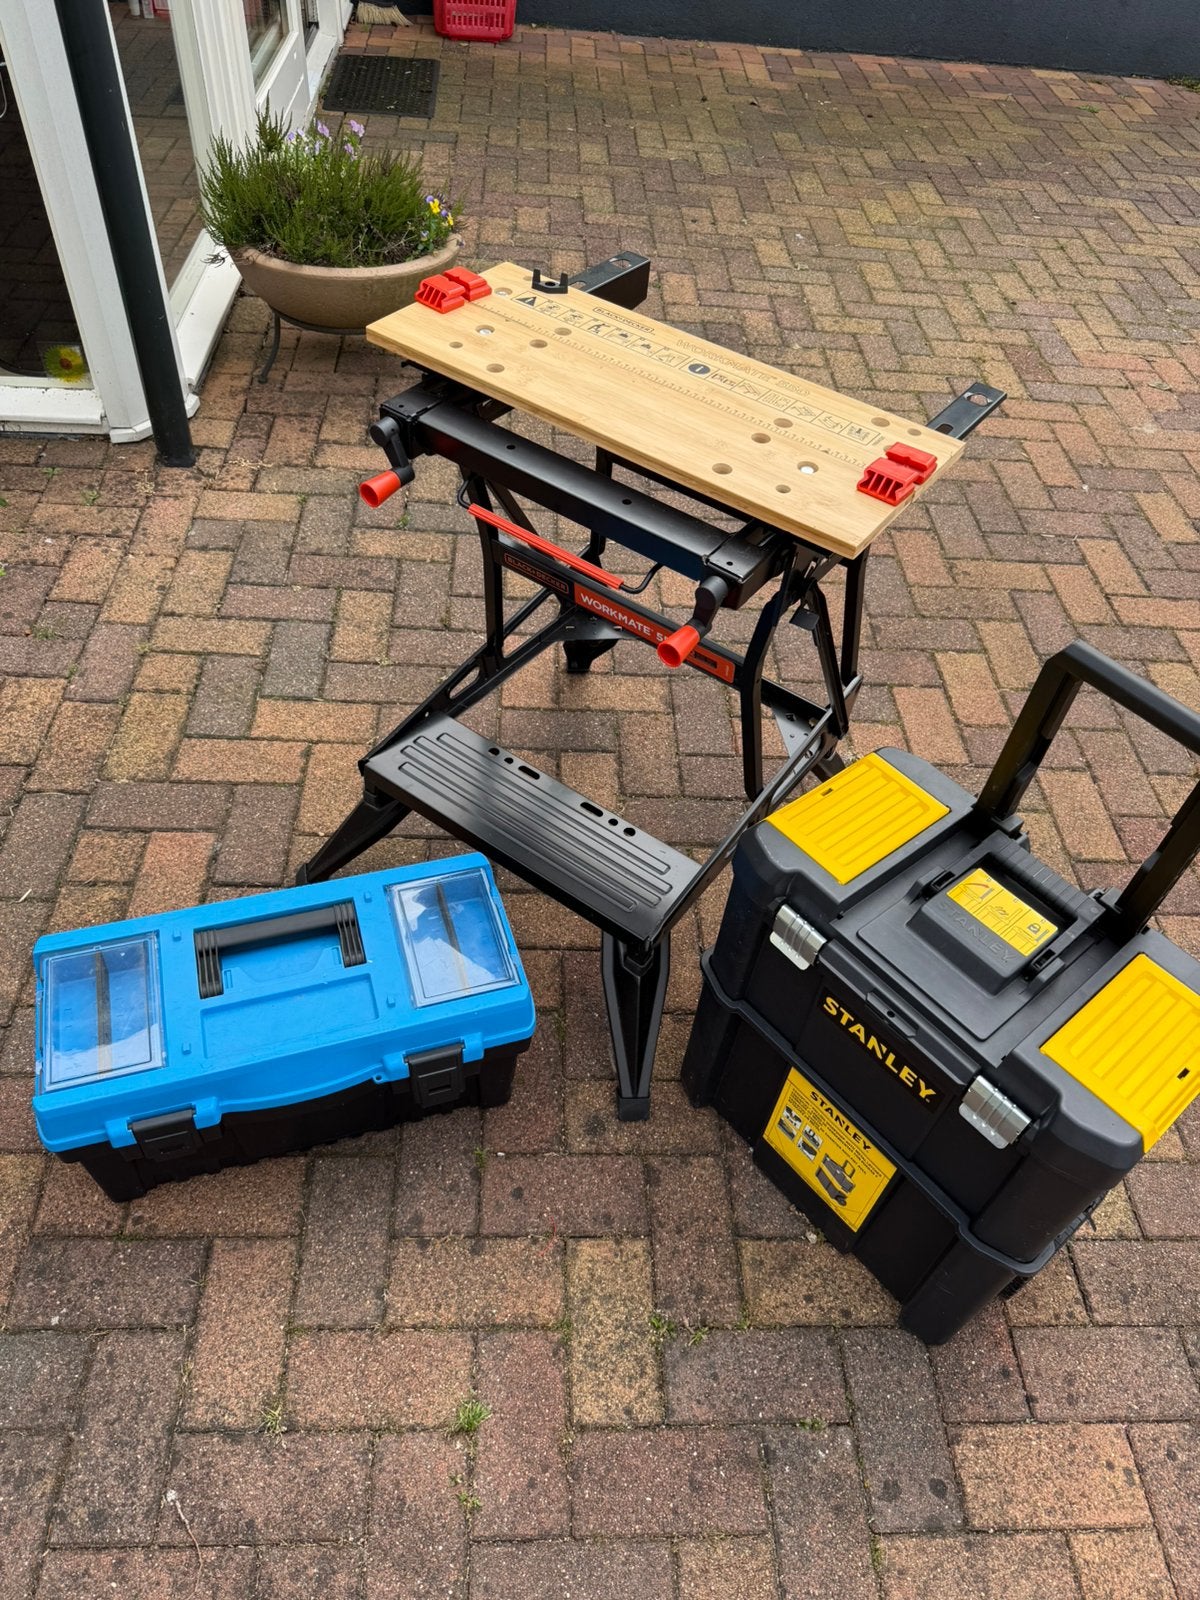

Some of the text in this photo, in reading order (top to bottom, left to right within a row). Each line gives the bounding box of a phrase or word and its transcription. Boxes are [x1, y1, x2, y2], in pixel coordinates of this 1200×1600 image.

[581, 592, 652, 636] WORKMATE
[937, 900, 1016, 962] STANLEY
[823, 996, 936, 1100] STANLEY
[810, 1091, 871, 1150] STANLEY
